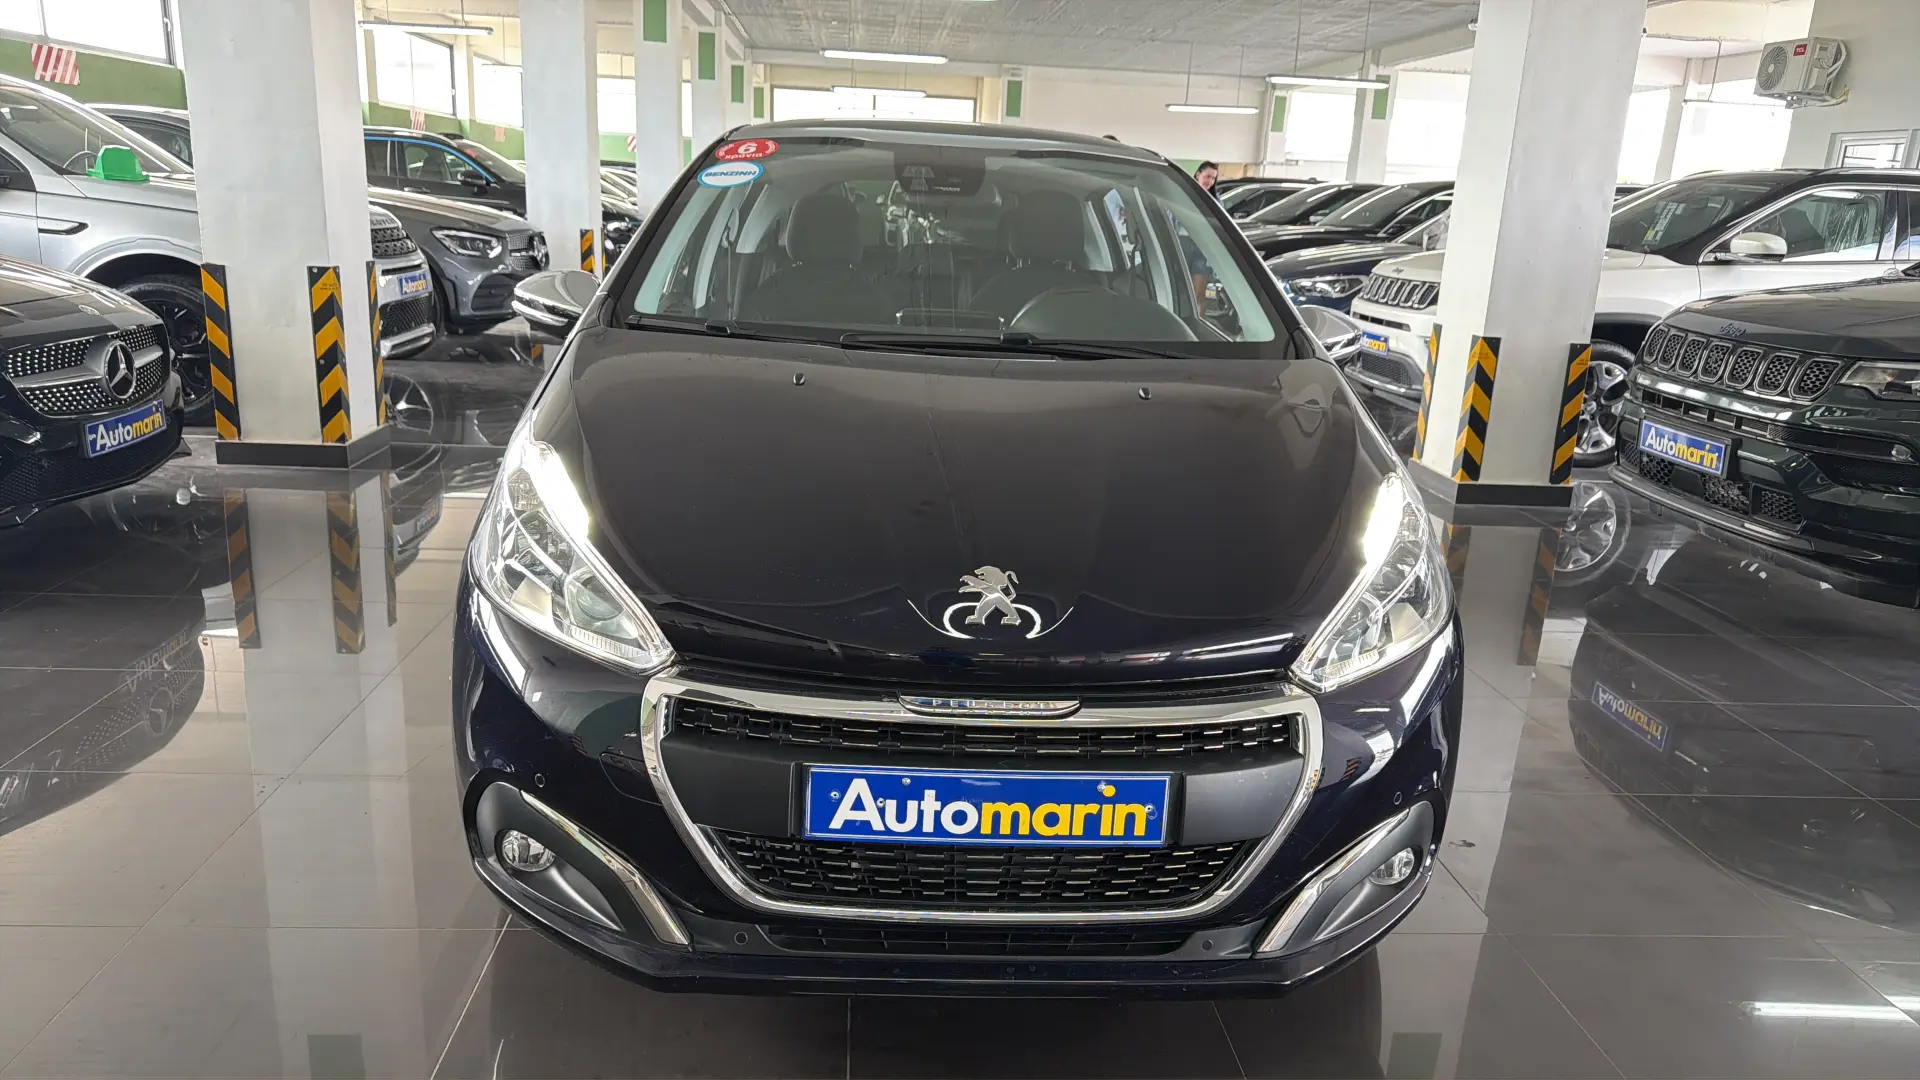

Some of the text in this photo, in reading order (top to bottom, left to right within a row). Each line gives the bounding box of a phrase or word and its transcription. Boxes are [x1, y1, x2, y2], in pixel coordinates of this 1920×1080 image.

[738, 142, 758, 154] 6
[96, 406, 164, 450] Automarin
[1644, 426, 1718, 469] Automarin
[932, 698, 1049, 709] PEUGEOT
[828, 778, 1146, 836] Automarin
